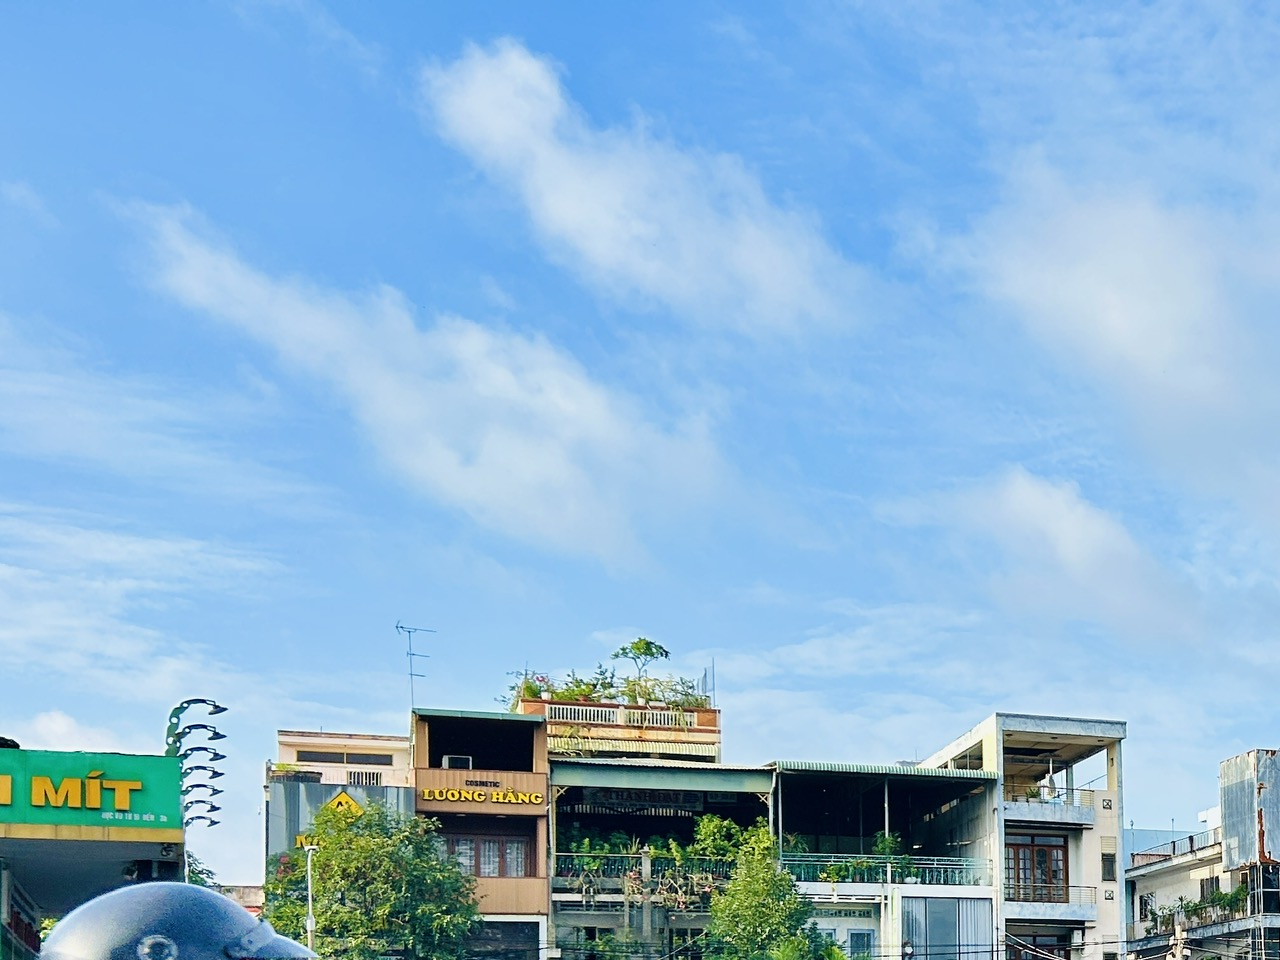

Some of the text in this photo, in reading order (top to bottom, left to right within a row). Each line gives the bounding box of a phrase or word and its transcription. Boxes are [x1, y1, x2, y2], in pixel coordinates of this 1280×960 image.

[31, 770, 143, 811] MÍT
[465, 780, 501, 788] COSMETIC
[422, 786, 544, 804] LƯƠNG HẰNG
